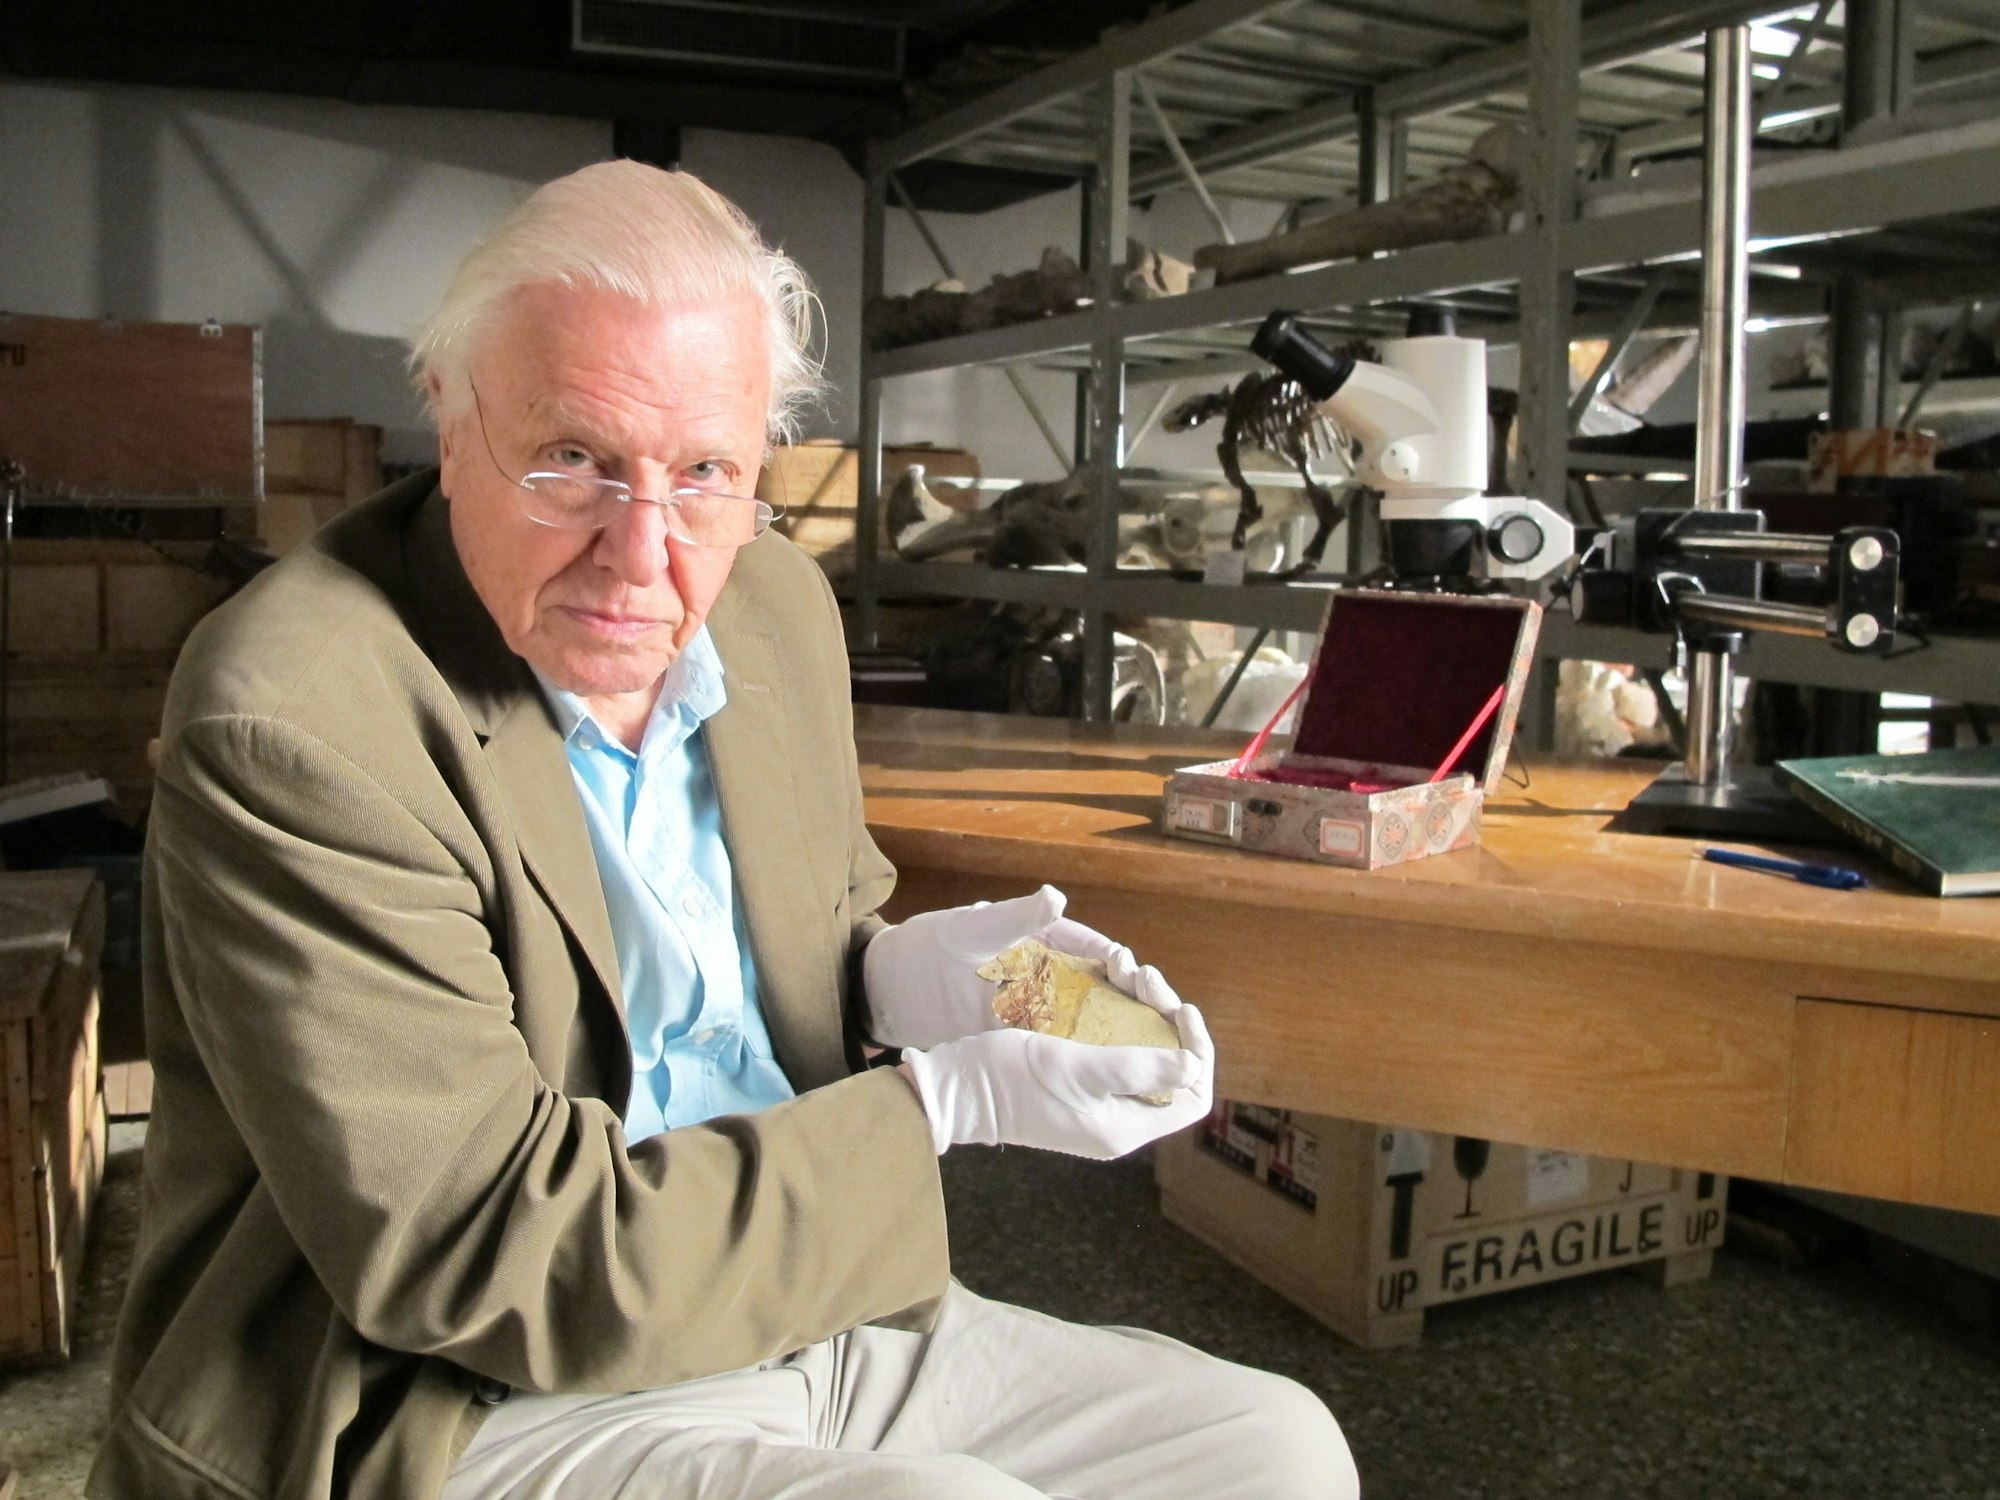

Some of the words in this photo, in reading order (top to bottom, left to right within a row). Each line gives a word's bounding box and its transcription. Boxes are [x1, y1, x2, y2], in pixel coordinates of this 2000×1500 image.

[1440, 1203, 1664, 1291] FRAGILE
[1685, 1208, 1720, 1247] UP
[1377, 1268, 1419, 1312] UP
